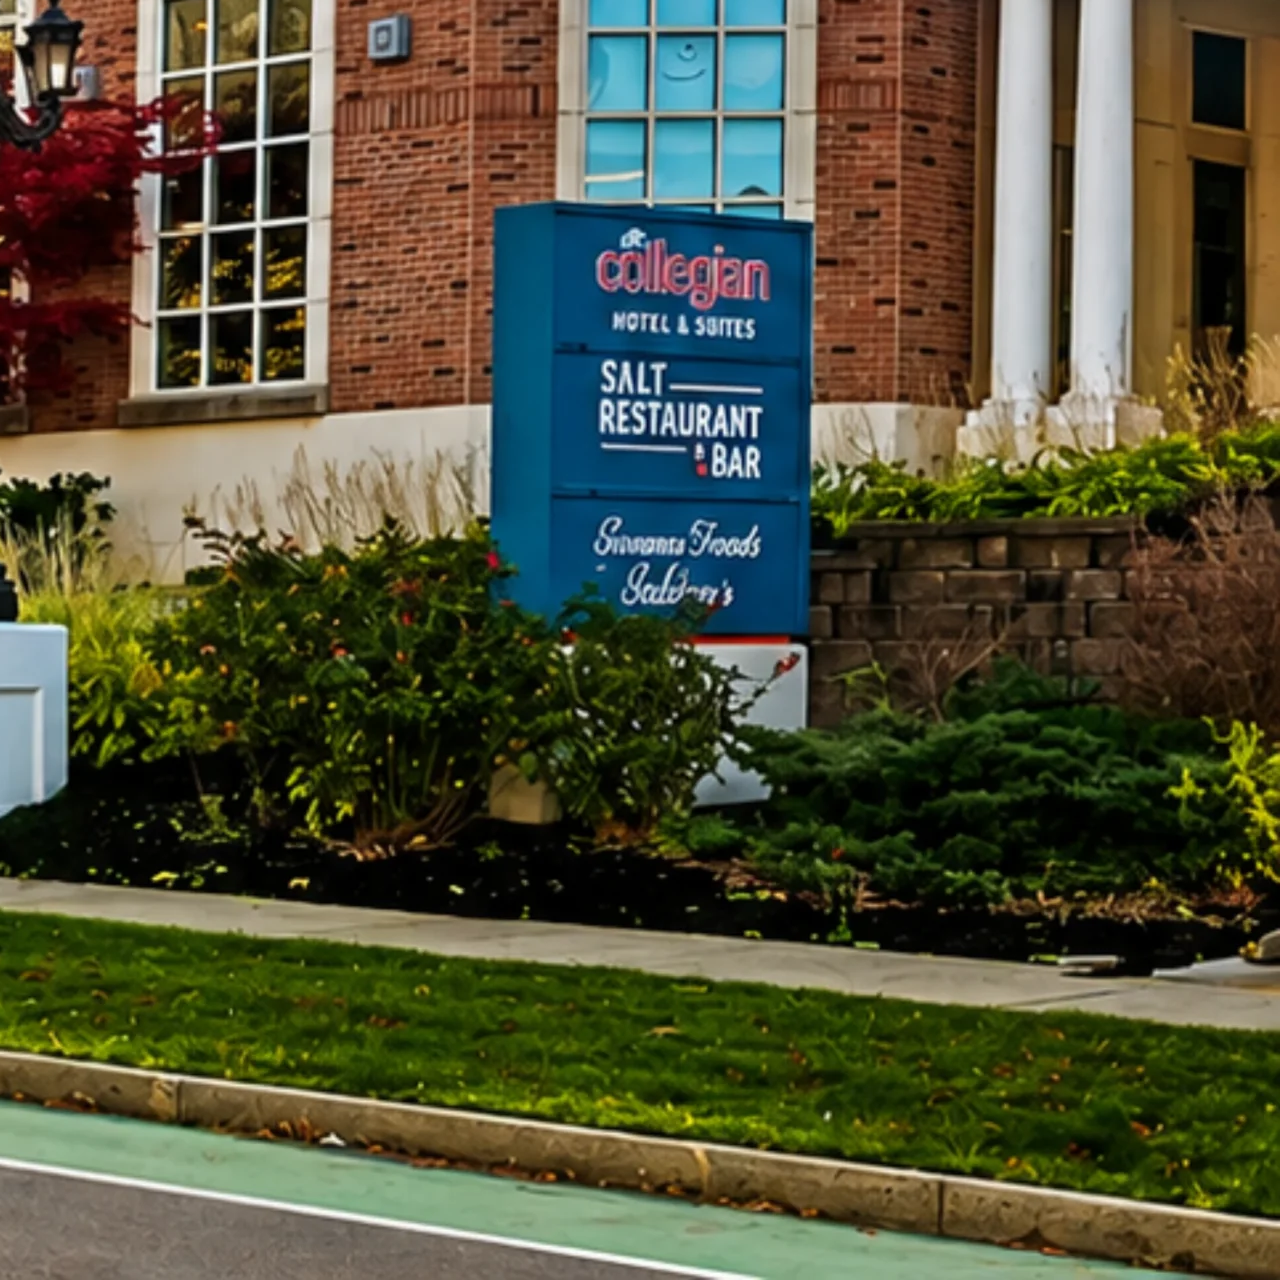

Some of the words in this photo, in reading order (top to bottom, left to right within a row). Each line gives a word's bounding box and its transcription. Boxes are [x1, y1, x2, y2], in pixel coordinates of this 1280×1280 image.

[595, 237, 771, 311] collegian
[612, 311, 671, 334] HOTEL
[693, 315, 757, 340] SUITES
[600, 359, 668, 397] SALT
[598, 398, 764, 440] RESTAURANT
[710, 441, 762, 480] BAR
